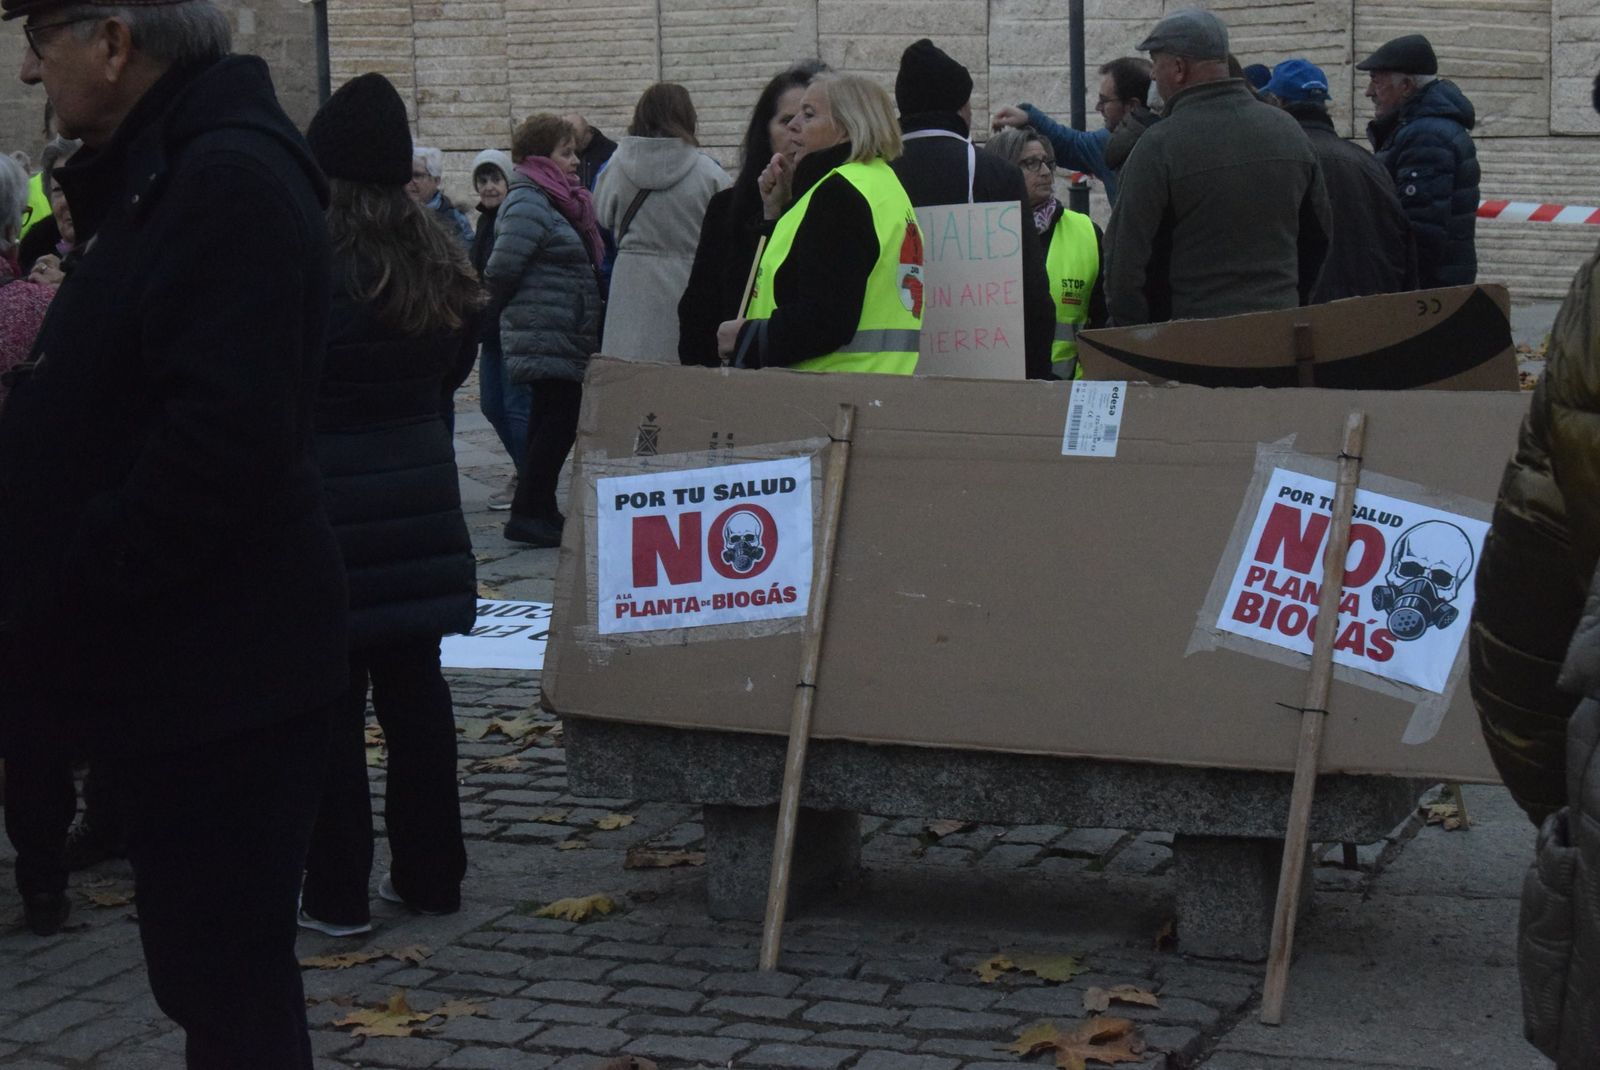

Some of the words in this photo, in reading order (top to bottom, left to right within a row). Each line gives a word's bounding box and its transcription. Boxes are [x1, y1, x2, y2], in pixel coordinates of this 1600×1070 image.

[960, 279, 1019, 307] AIRE
[1061, 278, 1085, 291] STOP
[920, 326, 1010, 354] IERRA
[1108, 386, 1119, 416] edesa
[615, 490, 666, 511] POR
[673, 486, 705, 506] TU
[713, 477, 797, 502] SALUD
[1278, 486, 1315, 506] POR
[632, 503, 779, 588] NO
[1254, 502, 1386, 588] NO
[615, 596, 701, 619] PLANTA
[712, 582, 798, 610] BIOGÁS
[1244, 566, 1361, 617] PLANA
